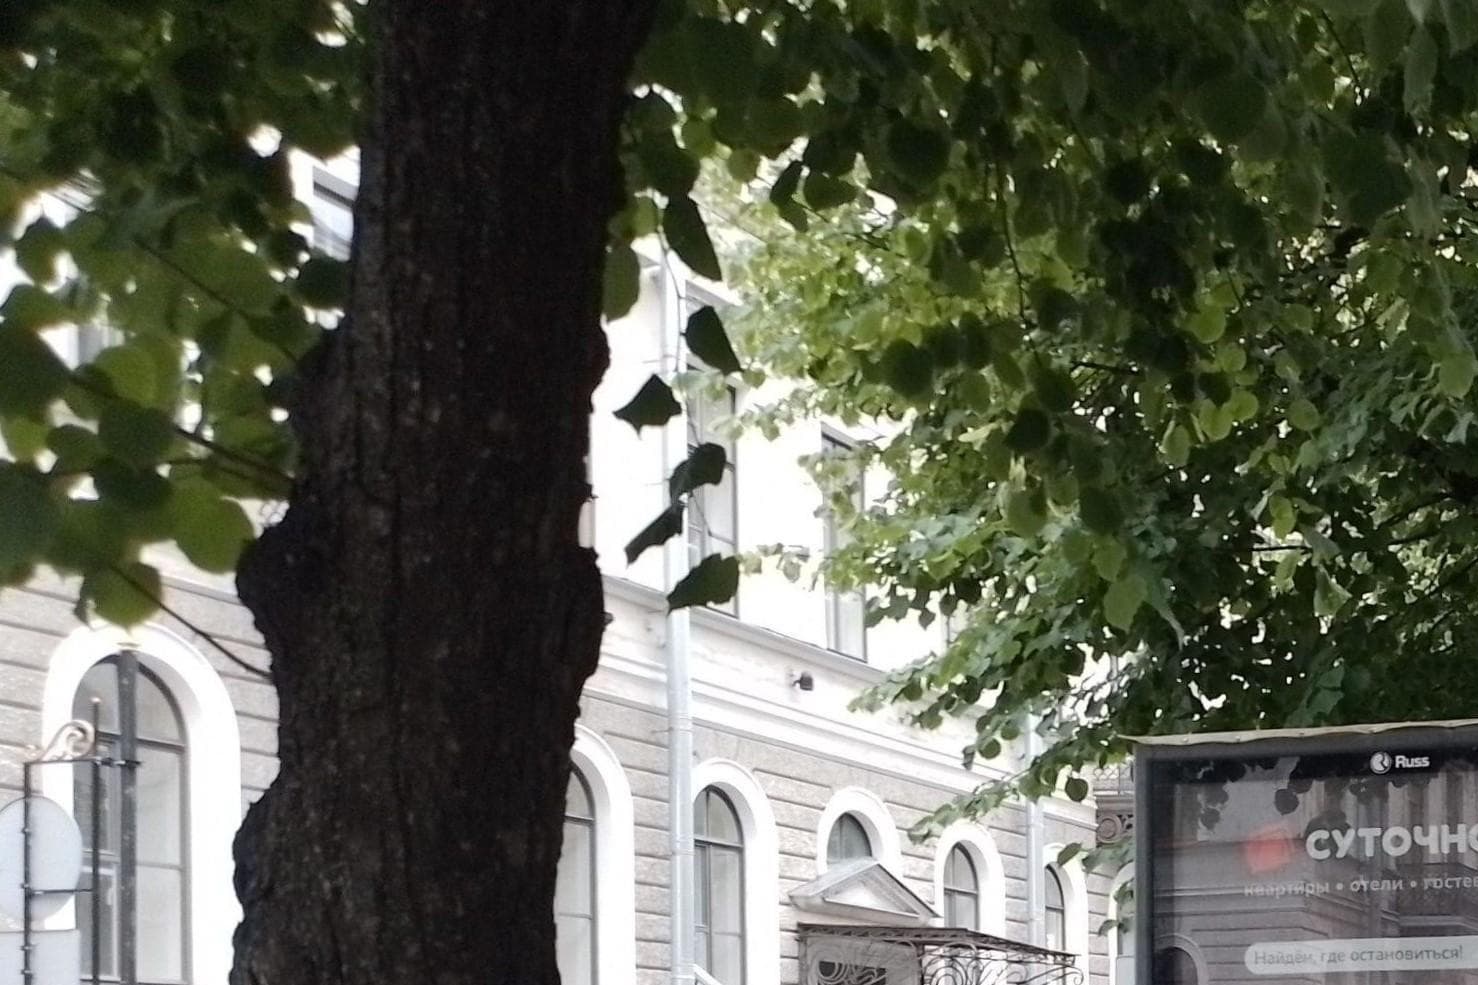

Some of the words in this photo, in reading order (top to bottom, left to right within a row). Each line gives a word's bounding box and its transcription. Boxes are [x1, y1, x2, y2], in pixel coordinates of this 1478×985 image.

[1395, 755, 1430, 768] Russ
[1244, 880, 1330, 899] квартиры
[1350, 876, 1403, 892] отели
[1320, 951, 1345, 964] где
[1350, 945, 1464, 962] остановиться!
